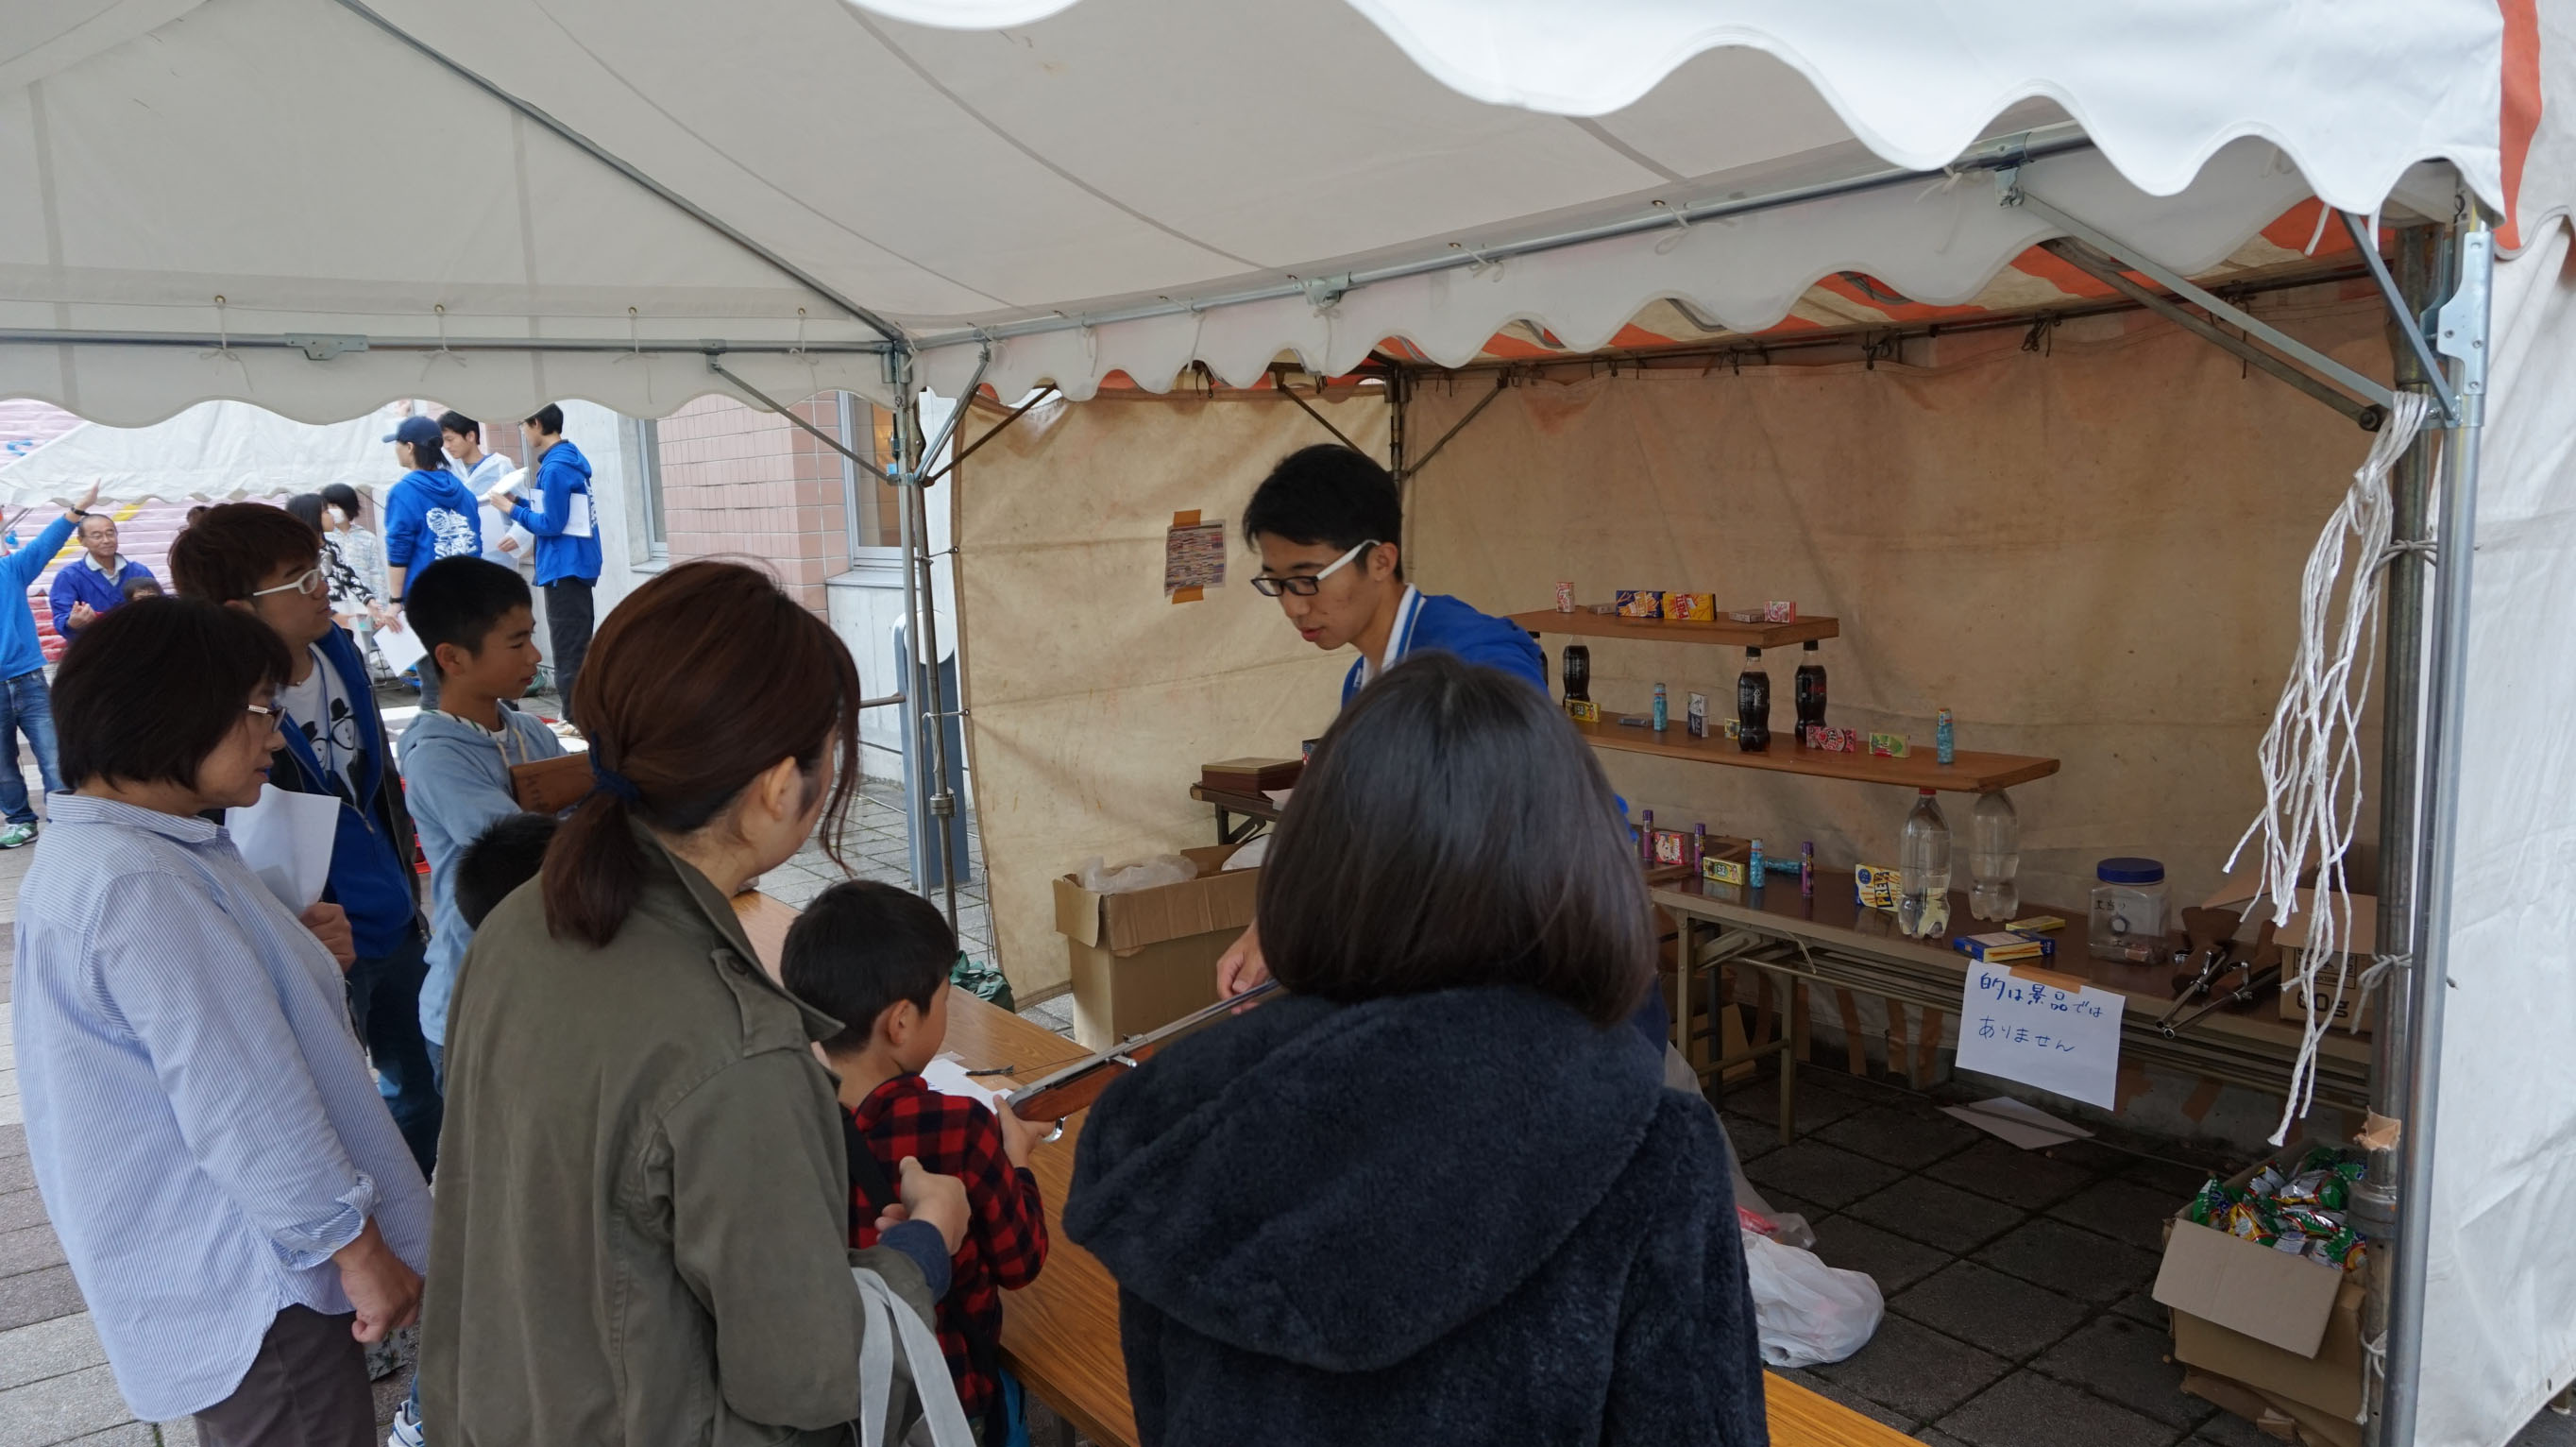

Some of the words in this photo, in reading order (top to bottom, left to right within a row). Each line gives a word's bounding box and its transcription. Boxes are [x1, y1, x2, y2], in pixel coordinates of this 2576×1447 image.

[1980, 972, 2103, 1017] 的は景品では
[1978, 1015, 2075, 1052] ありません
